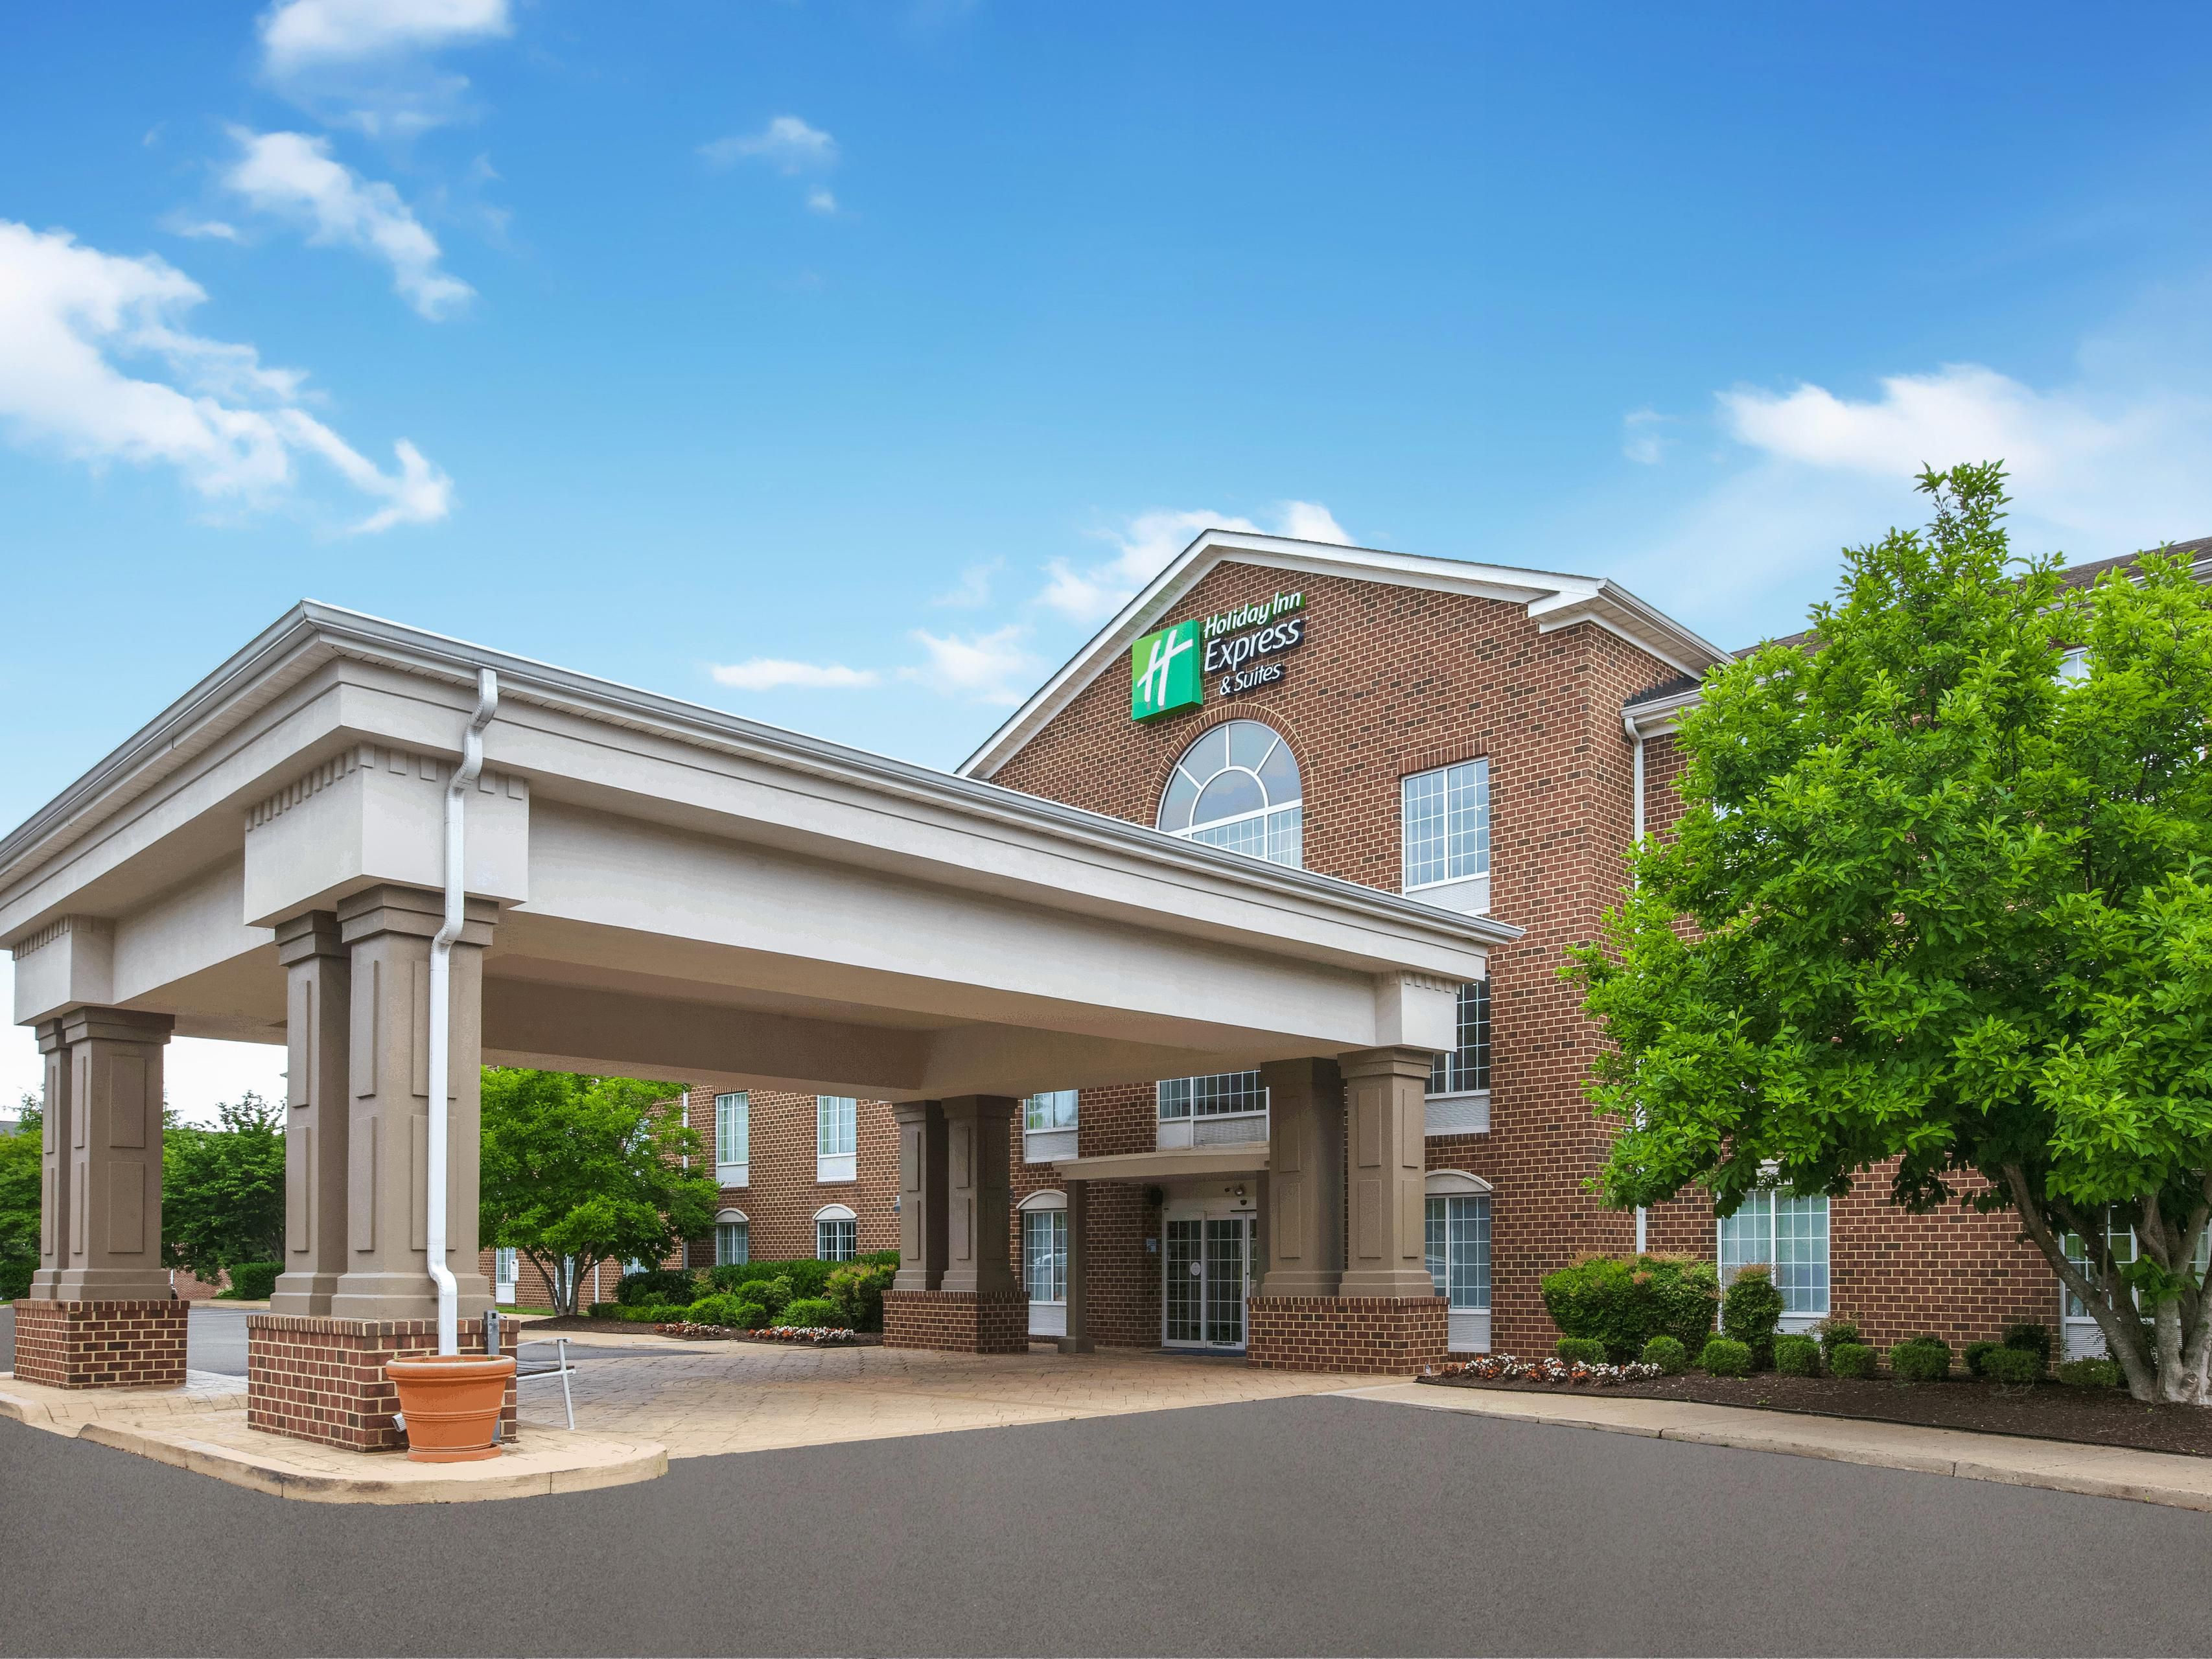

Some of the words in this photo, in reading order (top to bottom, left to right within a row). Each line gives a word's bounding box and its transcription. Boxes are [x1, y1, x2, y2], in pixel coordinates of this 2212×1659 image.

[1204, 603, 1270, 639] Holiday
[1273, 592, 1301, 615] Inn
[1204, 619, 1301, 671] Express
[1220, 676, 1231, 695] &
[1234, 664, 1282, 691] Suites
